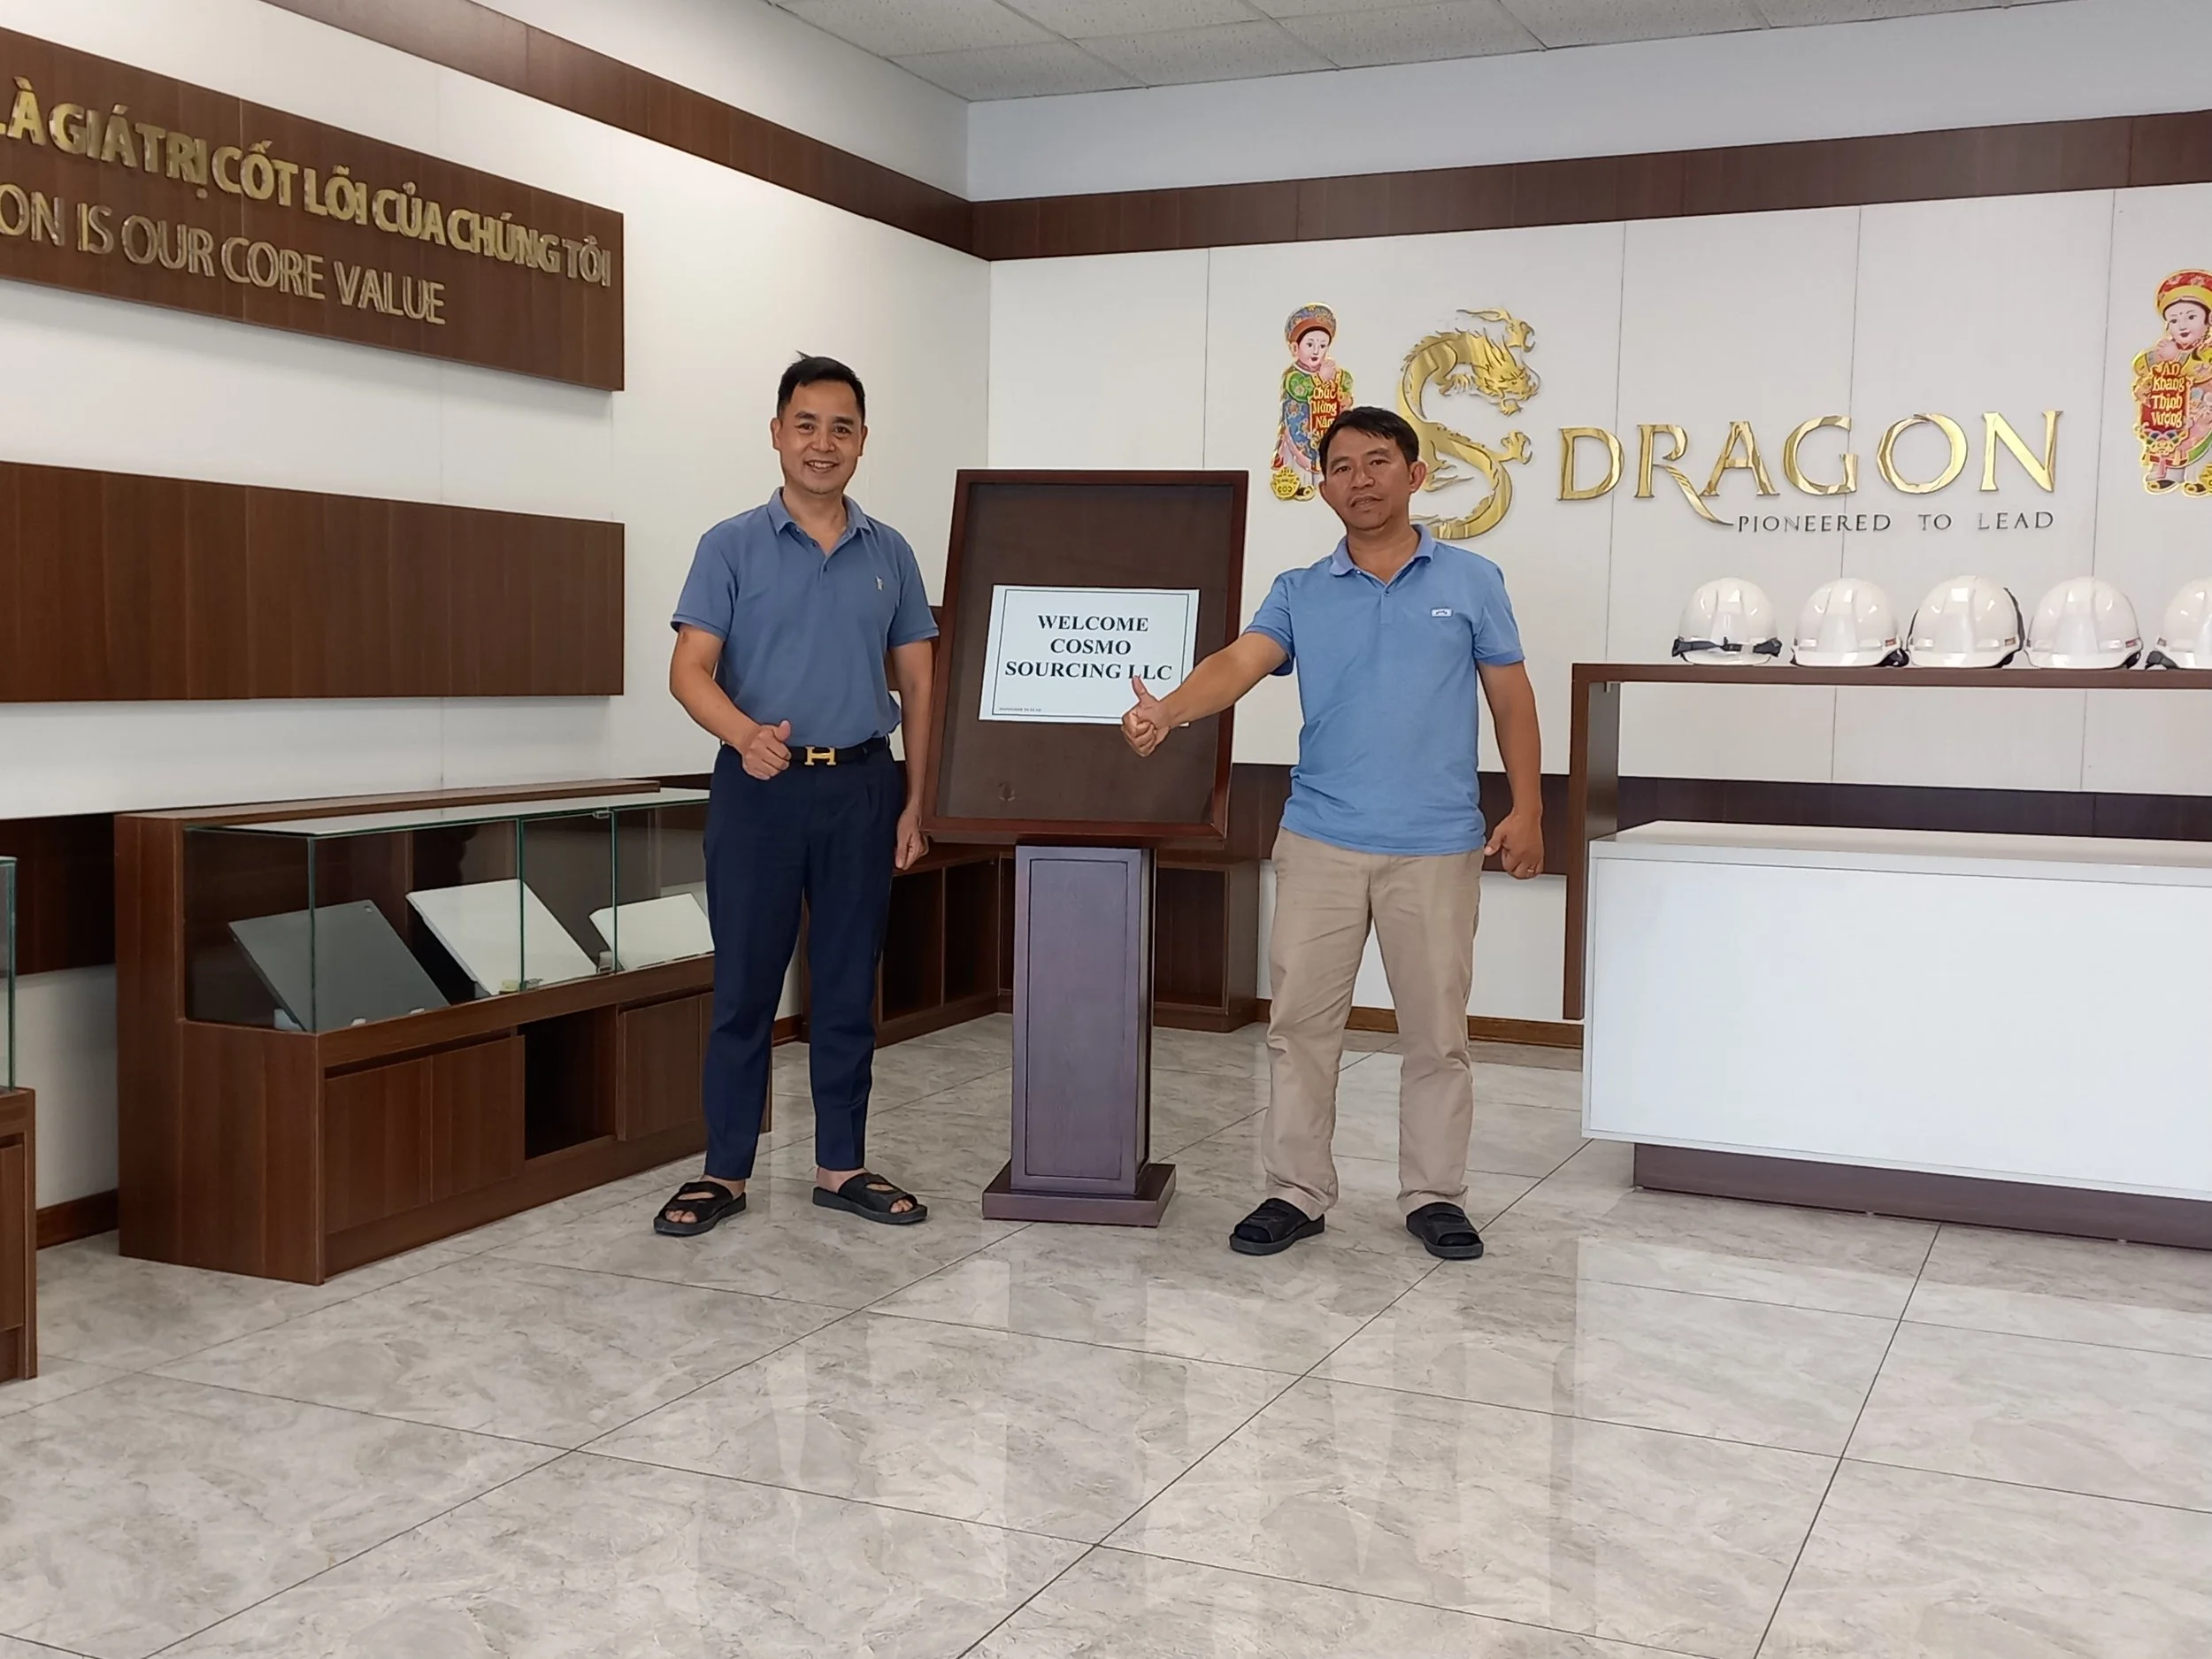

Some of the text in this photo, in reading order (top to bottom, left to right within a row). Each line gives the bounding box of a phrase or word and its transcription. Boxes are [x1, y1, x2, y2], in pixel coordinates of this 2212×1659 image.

[49, 104, 137, 167] GIÁ
[134, 122, 208, 199] TRỊ
[211, 140, 299, 206] CỐT
[372, 180, 446, 245] CỦA
[447, 211, 561, 273] CHÚNG
[561, 234, 611, 287] TÔI
[77, 203, 114, 254] IS
[121, 215, 215, 277] OUR
[221, 236, 326, 300] CORE
[334, 261, 446, 325] VALUE
[1556, 410, 2064, 526] DRAGON
[1738, 511, 2055, 533] PIONEERED TO LEAD
[1038, 614, 1148, 632] WELCOME
[1050, 638, 1132, 655] COSMO
[1005, 660, 1172, 680] SOURCING LLC
